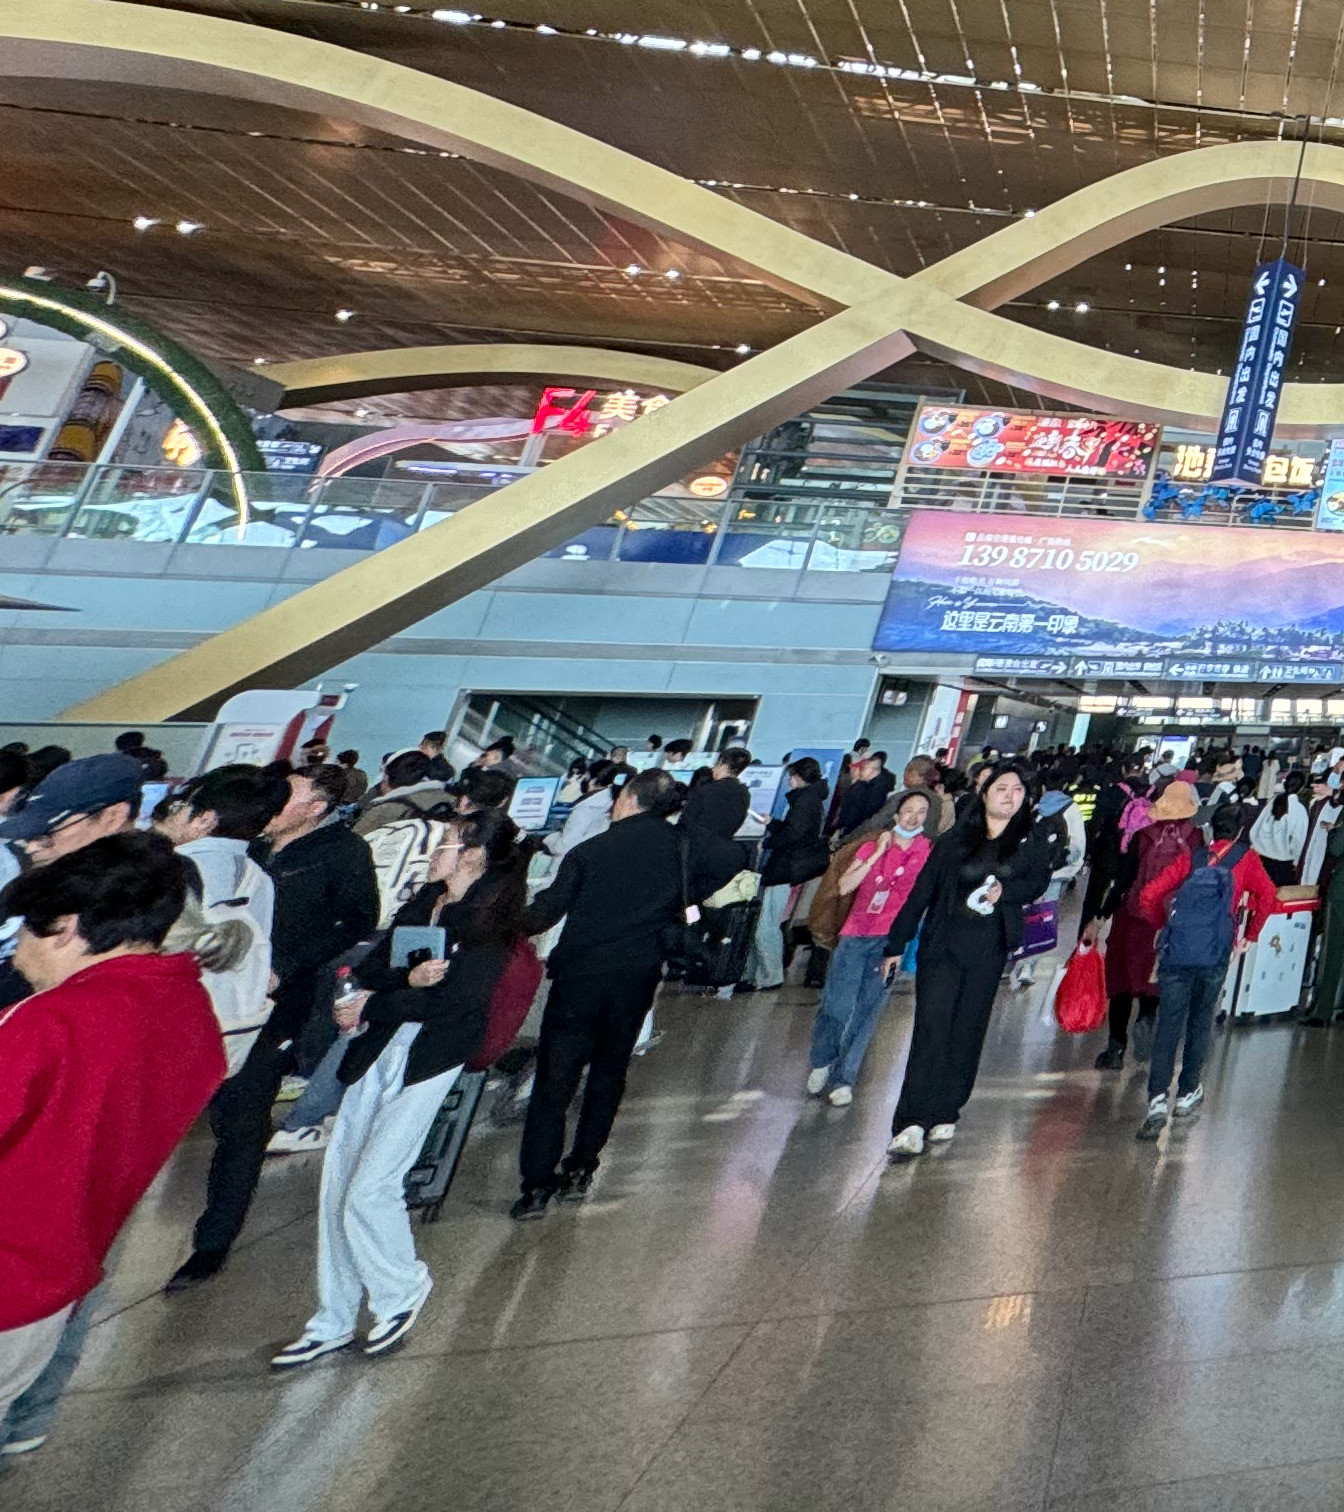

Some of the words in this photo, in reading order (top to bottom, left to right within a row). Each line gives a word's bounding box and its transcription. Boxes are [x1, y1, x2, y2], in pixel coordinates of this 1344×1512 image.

[957, 545, 1009, 567] 139
[1009, 549, 1074, 570] 8710
[1075, 551, 1140, 573] 5029
[940, 610, 1081, 635] 这里是云南第一印象
